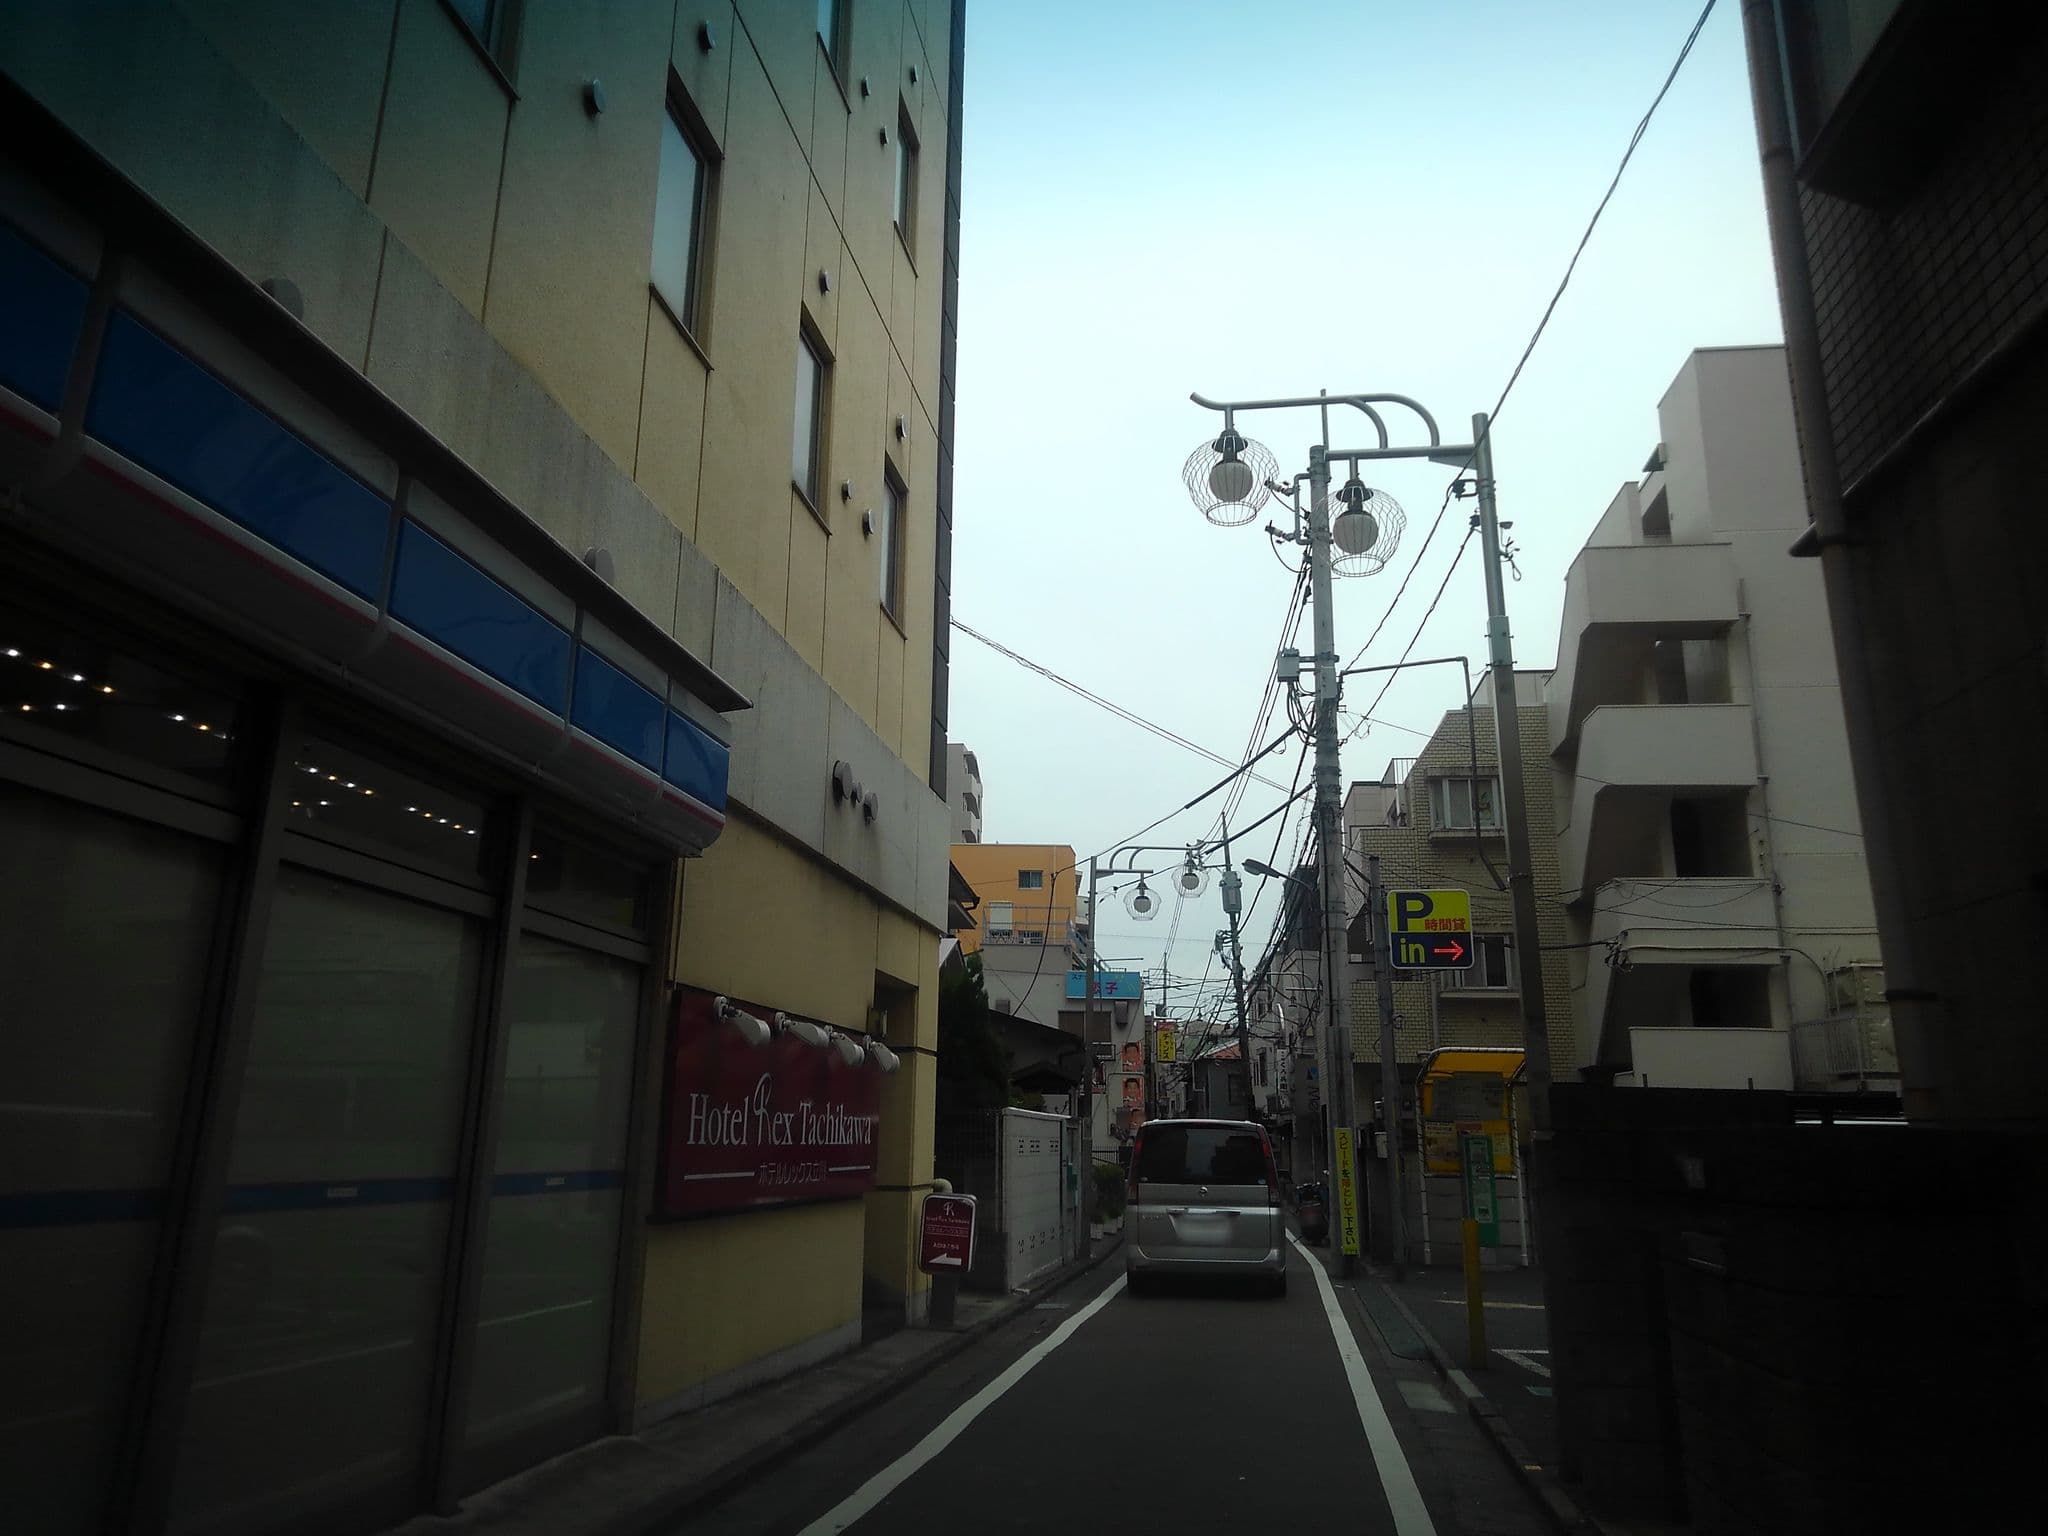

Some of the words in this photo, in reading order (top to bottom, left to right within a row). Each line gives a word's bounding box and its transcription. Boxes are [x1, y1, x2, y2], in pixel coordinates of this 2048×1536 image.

[1397, 892, 1434, 931] P
[1424, 918, 1466, 931] 時間貸
[1399, 937, 1426, 964] in
[687, 1093, 750, 1146] Hotel
[753, 1072, 794, 1146] Rex
[799, 1100, 872, 1145] Tachikawa
